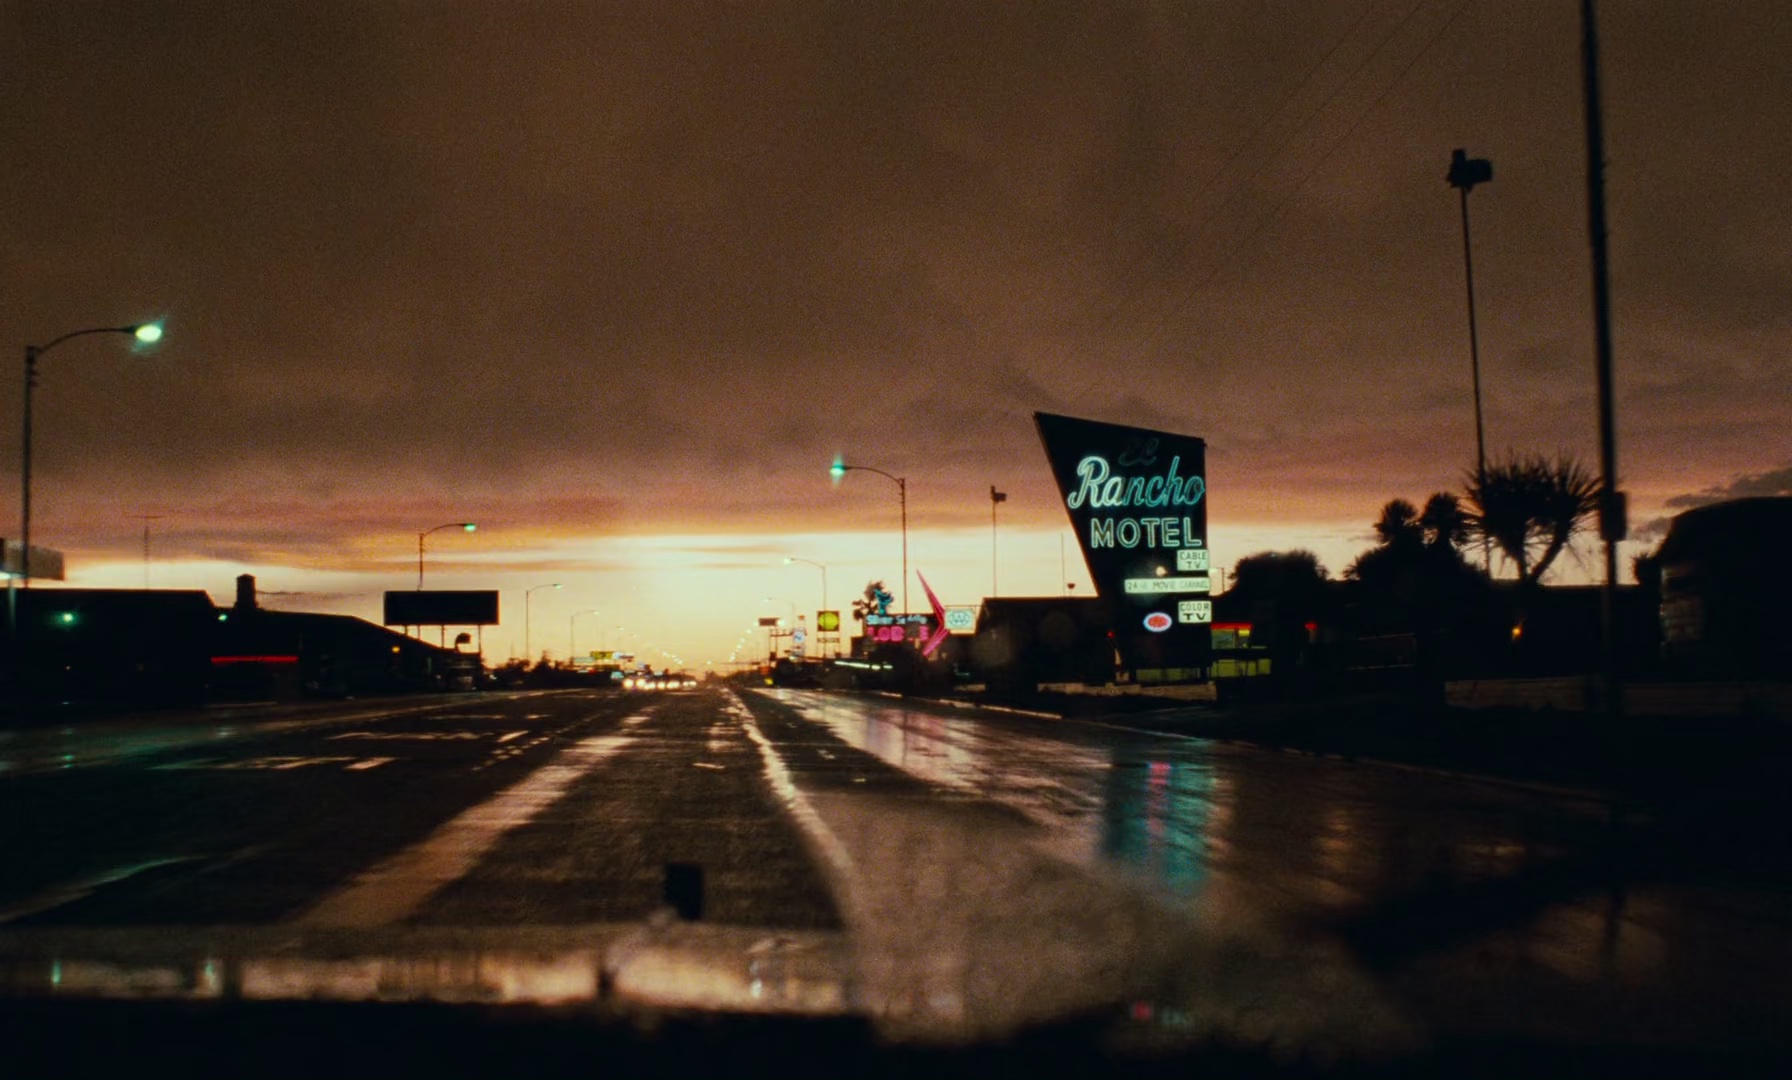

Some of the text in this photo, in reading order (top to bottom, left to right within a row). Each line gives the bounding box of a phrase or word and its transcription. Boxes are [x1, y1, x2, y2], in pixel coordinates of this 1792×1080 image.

[1067, 455, 1206, 509] Rancho
[1091, 517, 1203, 549] MOTEL
[1179, 551, 1207, 561] CABLE
[1186, 561, 1202, 569] TV
[1179, 602, 1210, 612] COLOR
[1183, 612, 1207, 621] TV
